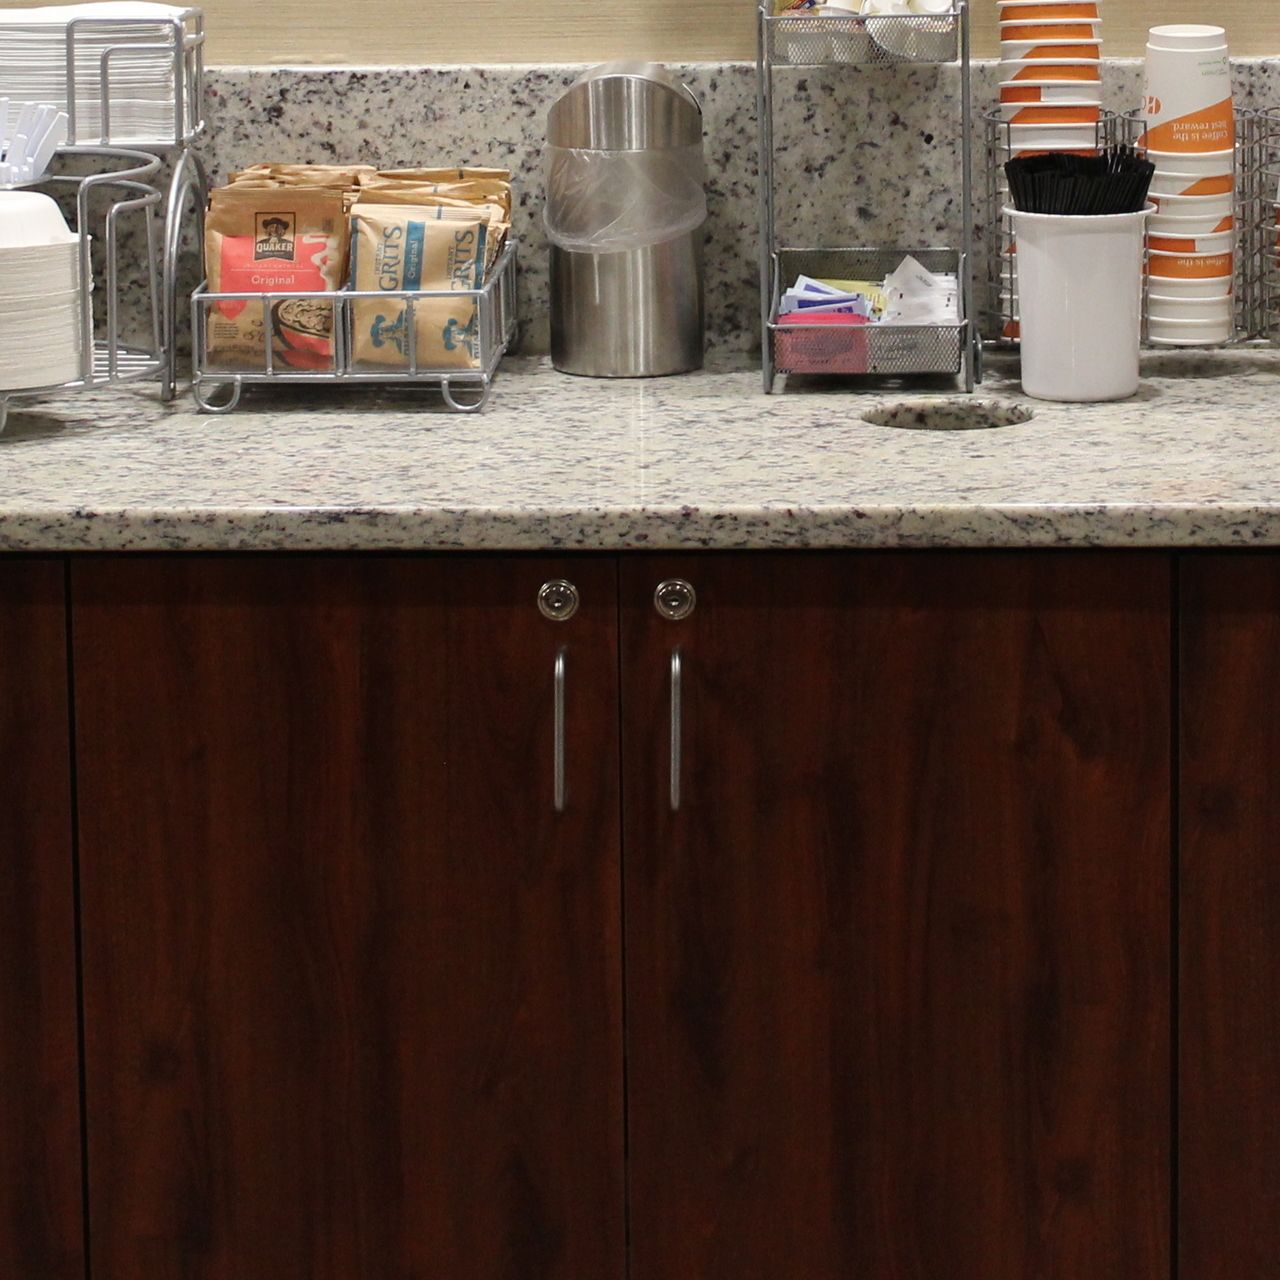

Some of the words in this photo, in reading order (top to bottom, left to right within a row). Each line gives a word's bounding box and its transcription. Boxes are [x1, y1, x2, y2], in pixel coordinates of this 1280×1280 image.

[256, 241, 294, 253] QUAKER
[378, 226, 403, 292] GRITS
[407, 240, 419, 280] Original
[251, 274, 295, 287] Original
